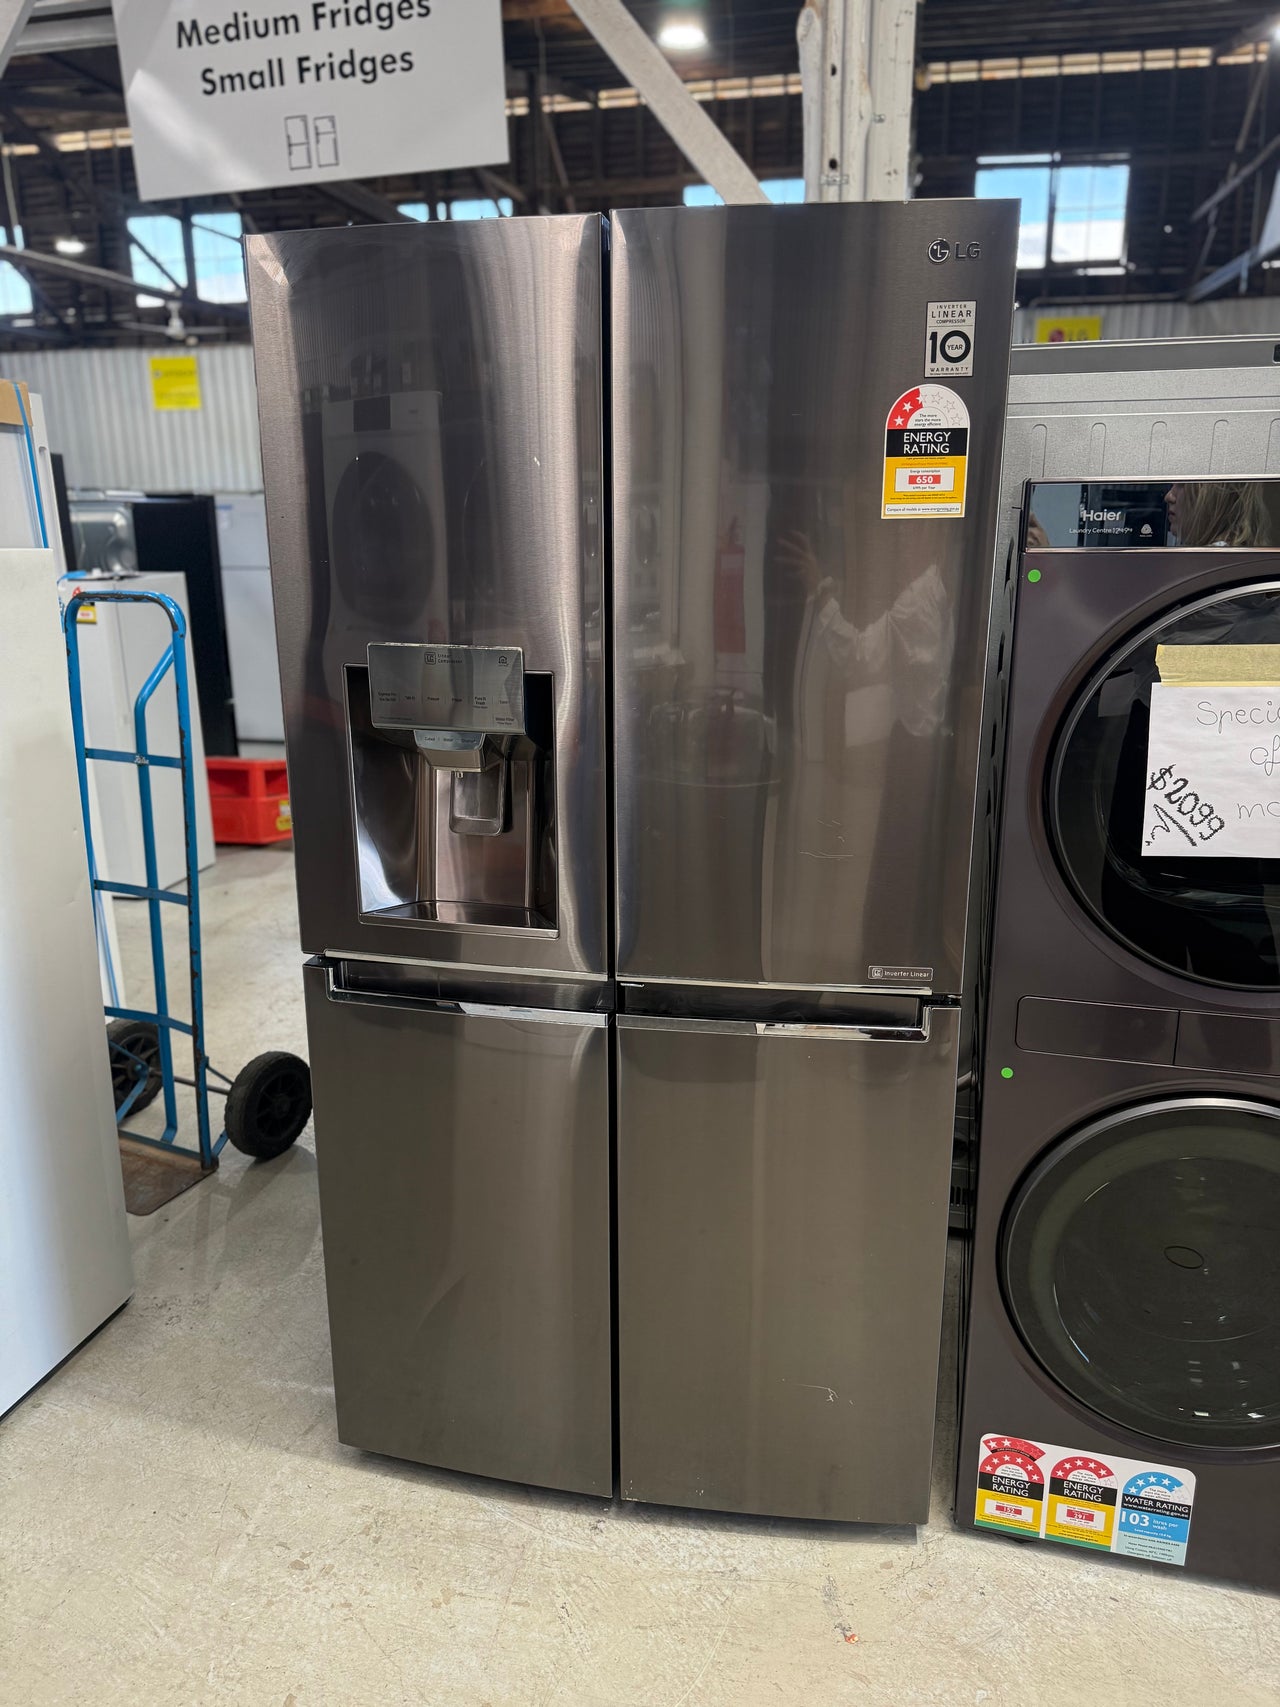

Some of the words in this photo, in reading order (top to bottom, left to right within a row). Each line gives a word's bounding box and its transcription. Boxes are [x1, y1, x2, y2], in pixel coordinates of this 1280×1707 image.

[176, 12, 300, 49] Medium
[311, 0, 432, 32] Fridges
[201, 57, 286, 97] Small
[298, 48, 415, 85] Fridges
[955, 242, 981, 260] LG
[931, 310, 973, 319] LINEAR
[929, 330, 971, 364] 10
[904, 432, 951, 443] ENERGY
[904, 444, 950, 454] RATING
[916, 476, 934, 484] 650
[1082, 509, 1122, 522] Haier
[1147, 763, 1225, 841] $2099
[992, 1476, 1031, 1489] ENERGY
[1064, 1481, 1104, 1494] ENERGY
[992, 1484, 1029, 1497] RATING
[1064, 1489, 1102, 1502] RATING
[1124, 1496, 1154, 1507] WATER
[1156, 1502, 1188, 1513] RATING
[1121, 1511, 1150, 1527] 103
